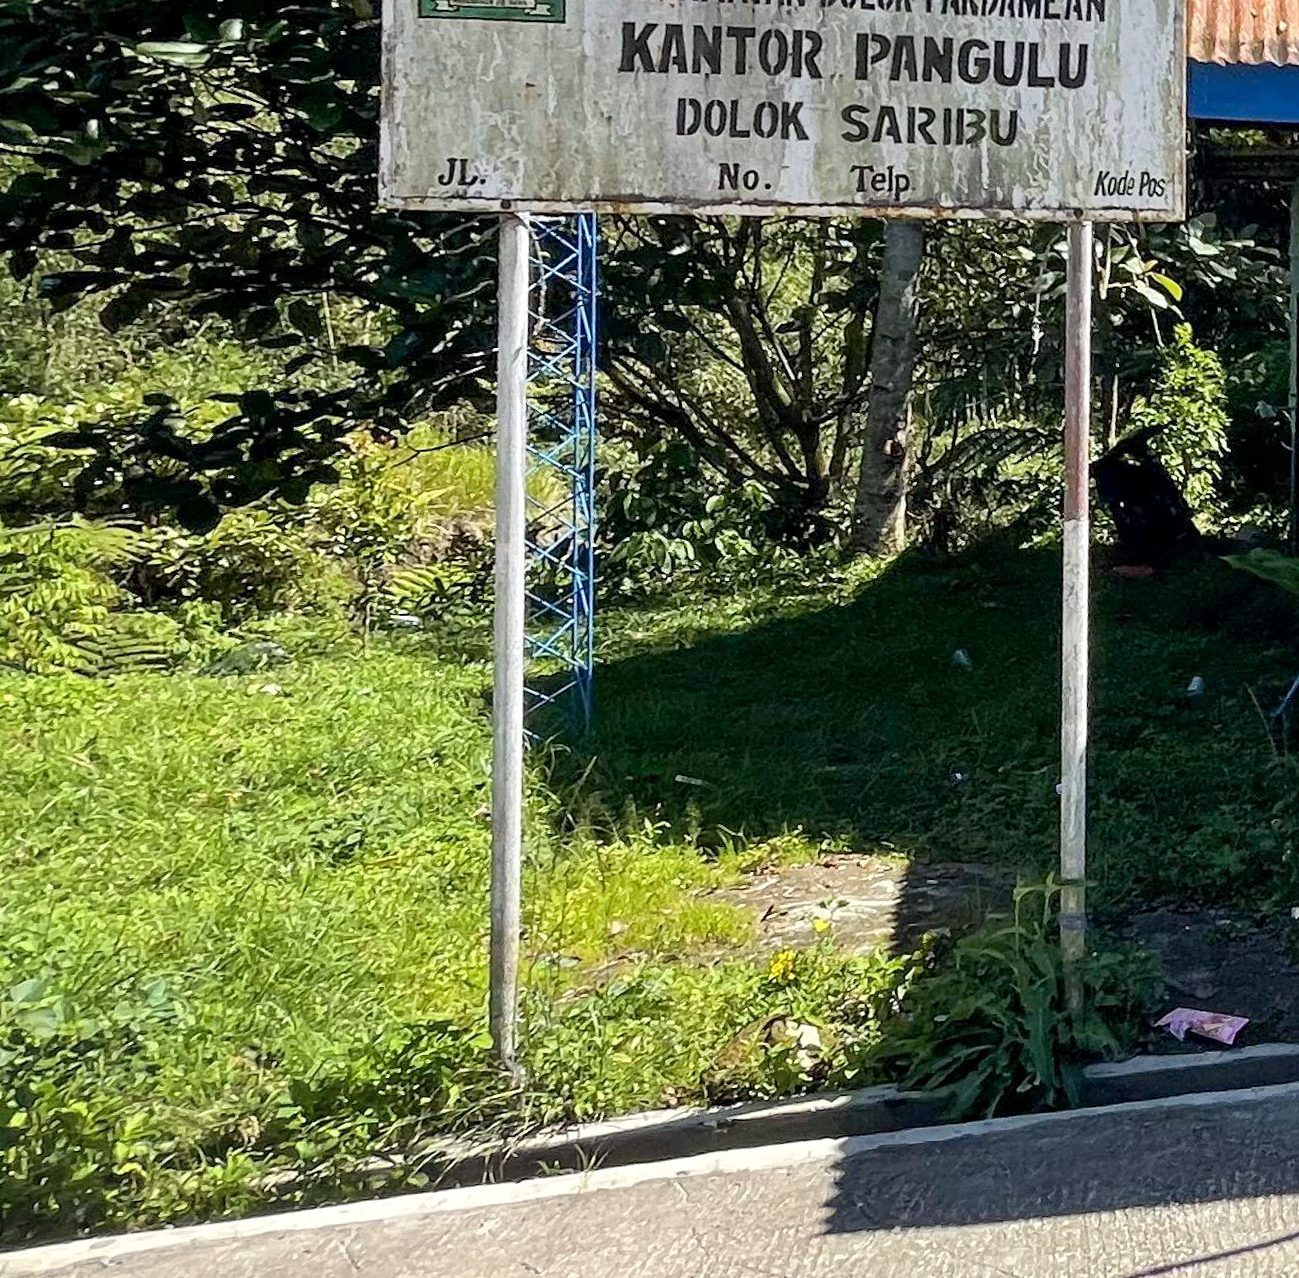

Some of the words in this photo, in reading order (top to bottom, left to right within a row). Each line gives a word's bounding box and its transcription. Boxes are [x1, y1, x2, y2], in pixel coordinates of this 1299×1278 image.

[618, 22, 822, 79] KANTOR
[855, 33, 1088, 89] PANGULU
[676, 98, 809, 140] DOLOK
[841, 104, 1018, 146] SARIBU
[718, 163, 772, 190] No.
[1094, 171, 1135, 196] Kode
[1138, 171, 1166, 198] Pos
